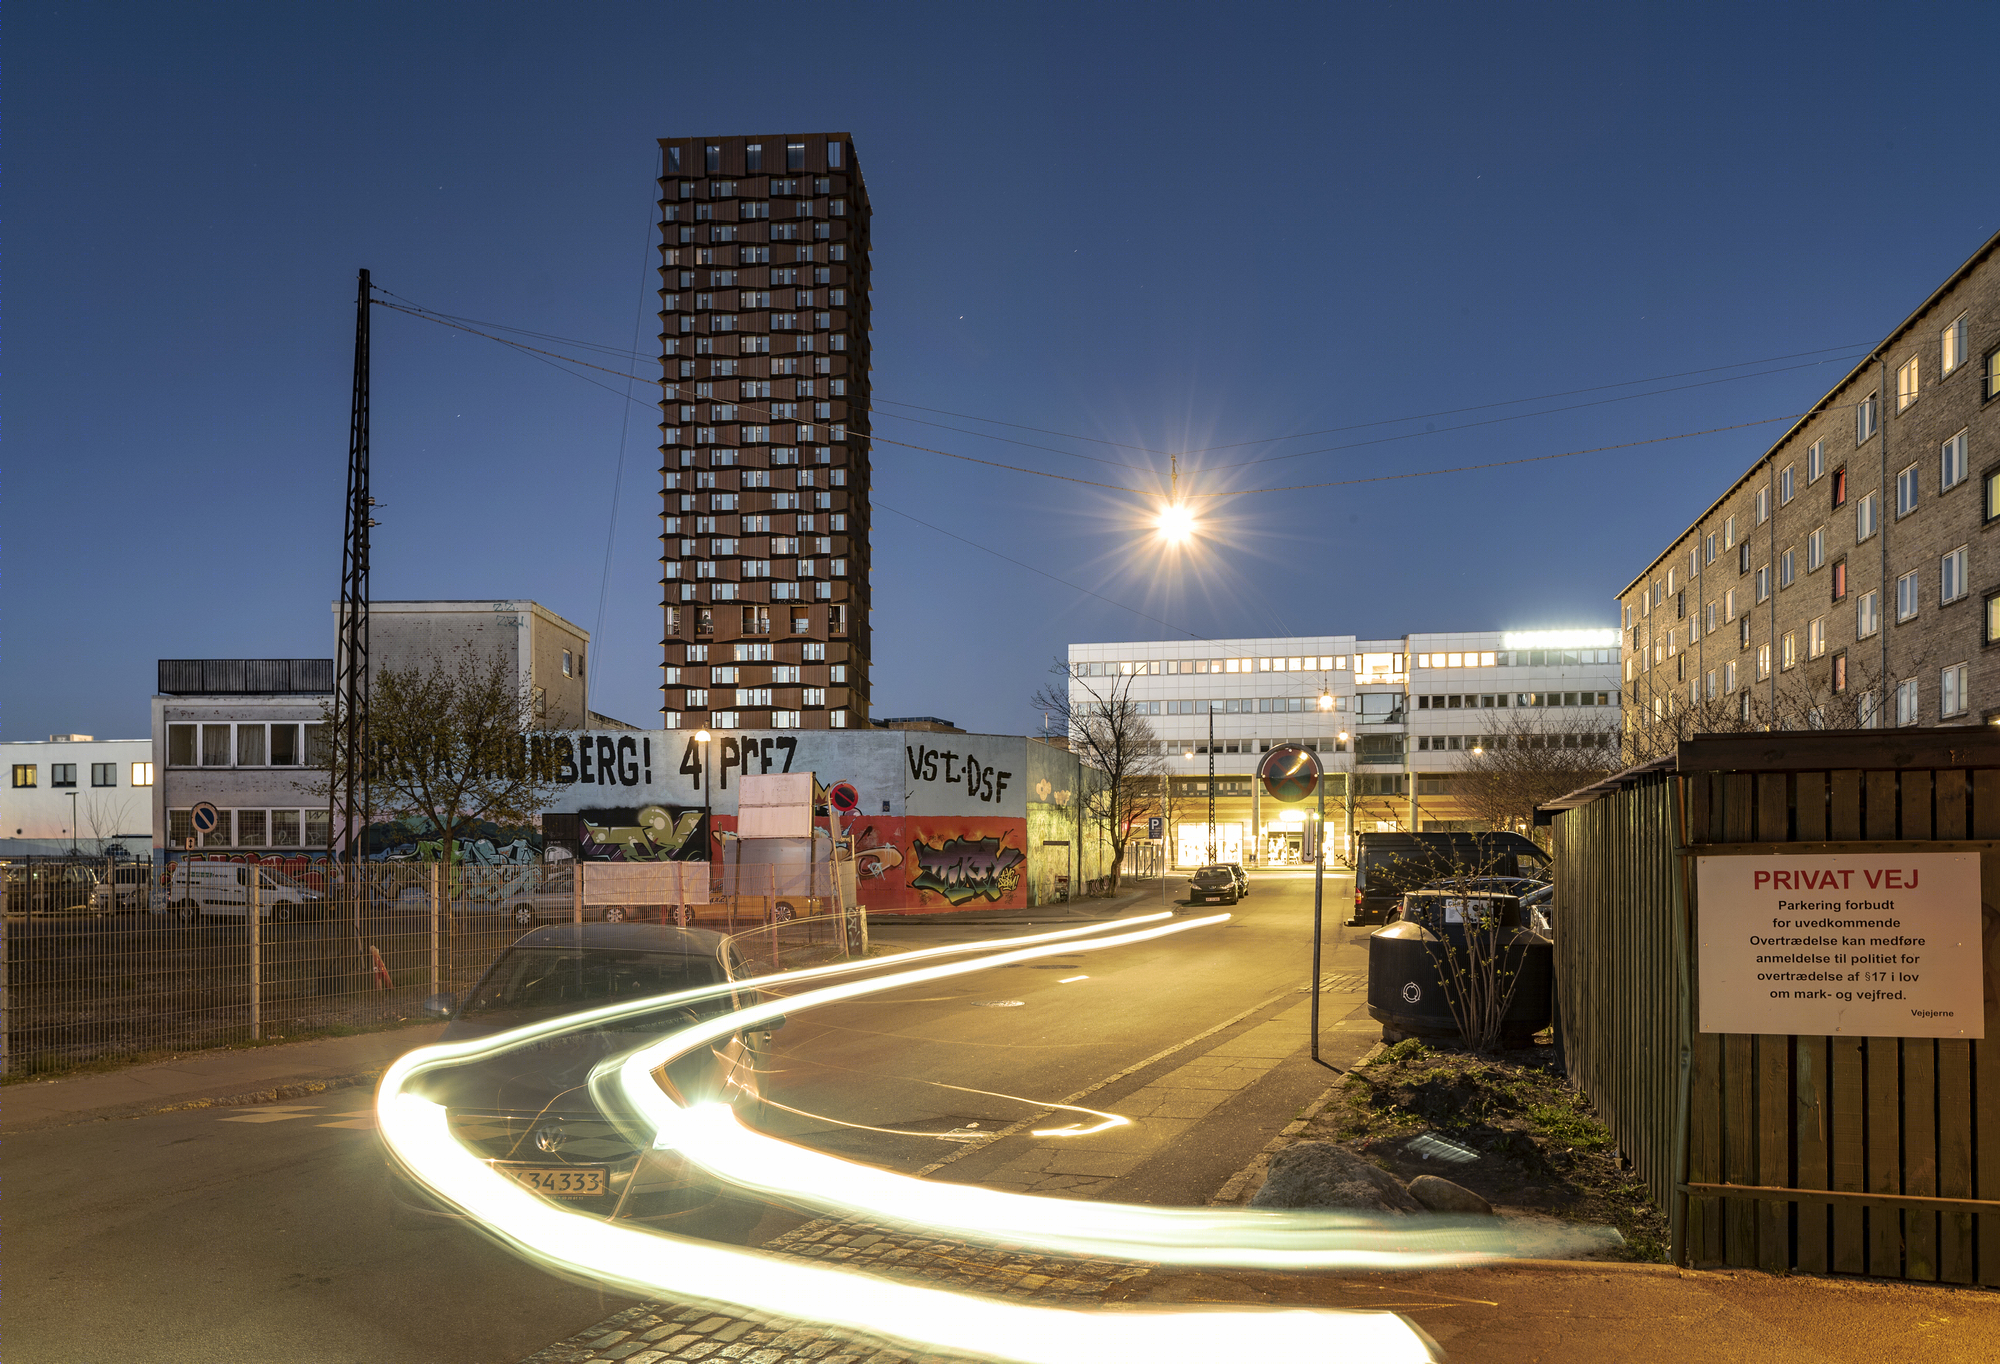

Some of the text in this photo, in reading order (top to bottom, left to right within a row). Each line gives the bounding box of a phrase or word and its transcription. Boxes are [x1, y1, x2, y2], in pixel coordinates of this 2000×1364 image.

[679, 736, 702, 790] 4
[1754, 869, 1918, 890] PRIVAT VEJ
[1778, 900, 1894, 912] Parkering forbudt
[1773, 918, 1900, 928] for uvedkommende
[1750, 936, 1925, 946] Overtrædelse kan medføre
[1756, 954, 1920, 966] anmeldelse til politiet for
[1757, 971, 1919, 982] overtrædelse af §17 i lov
[1770, 989, 1906, 1002] om mark- og vejfred.
[1911, 1010, 1954, 1018] Vejejerne
